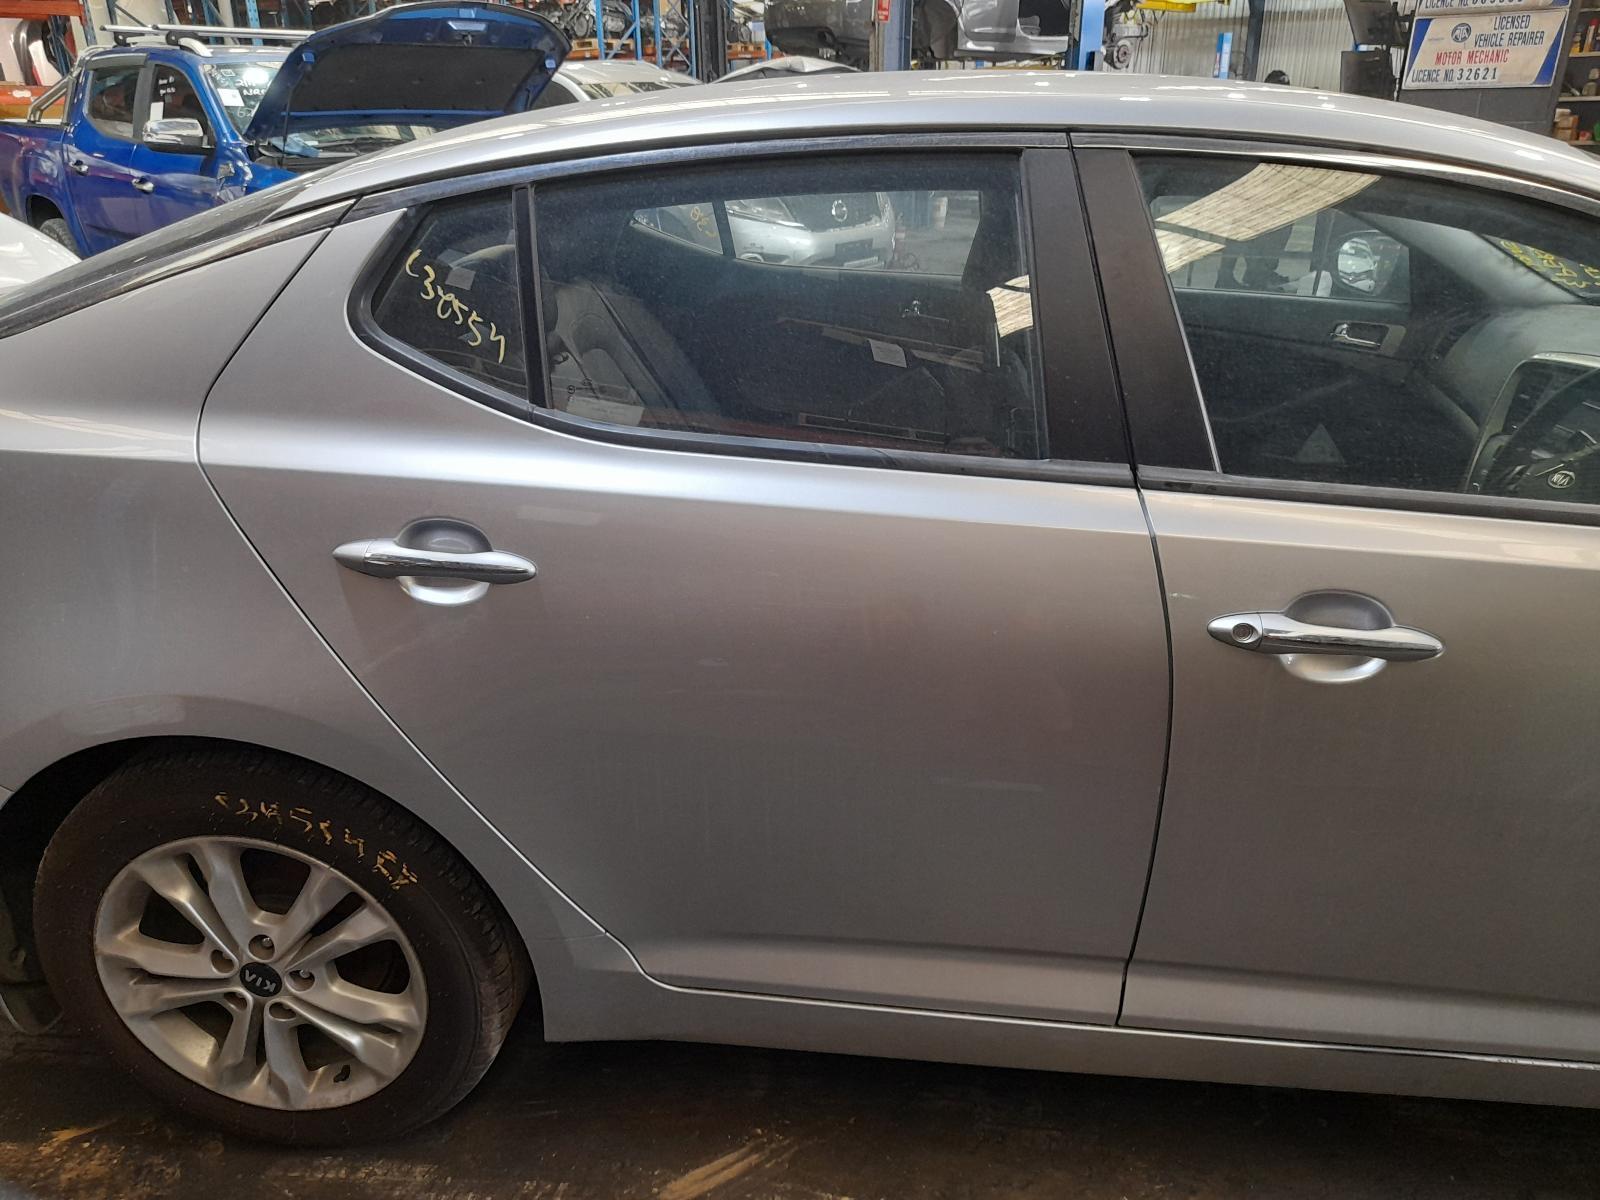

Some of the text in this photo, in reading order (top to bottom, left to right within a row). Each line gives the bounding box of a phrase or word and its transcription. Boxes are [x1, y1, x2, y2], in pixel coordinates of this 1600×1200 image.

[1493, 14, 1531, 31] LICENSED
[1474, 30, 1545, 48] VEHICLE REPAIRER
[1435, 48, 1510, 66] MOTOR MECHANIC
[1411, 68, 1441, 83] LICENCE
[1457, 66, 1498, 81] 32621
[245, 969, 277, 992] KIA
